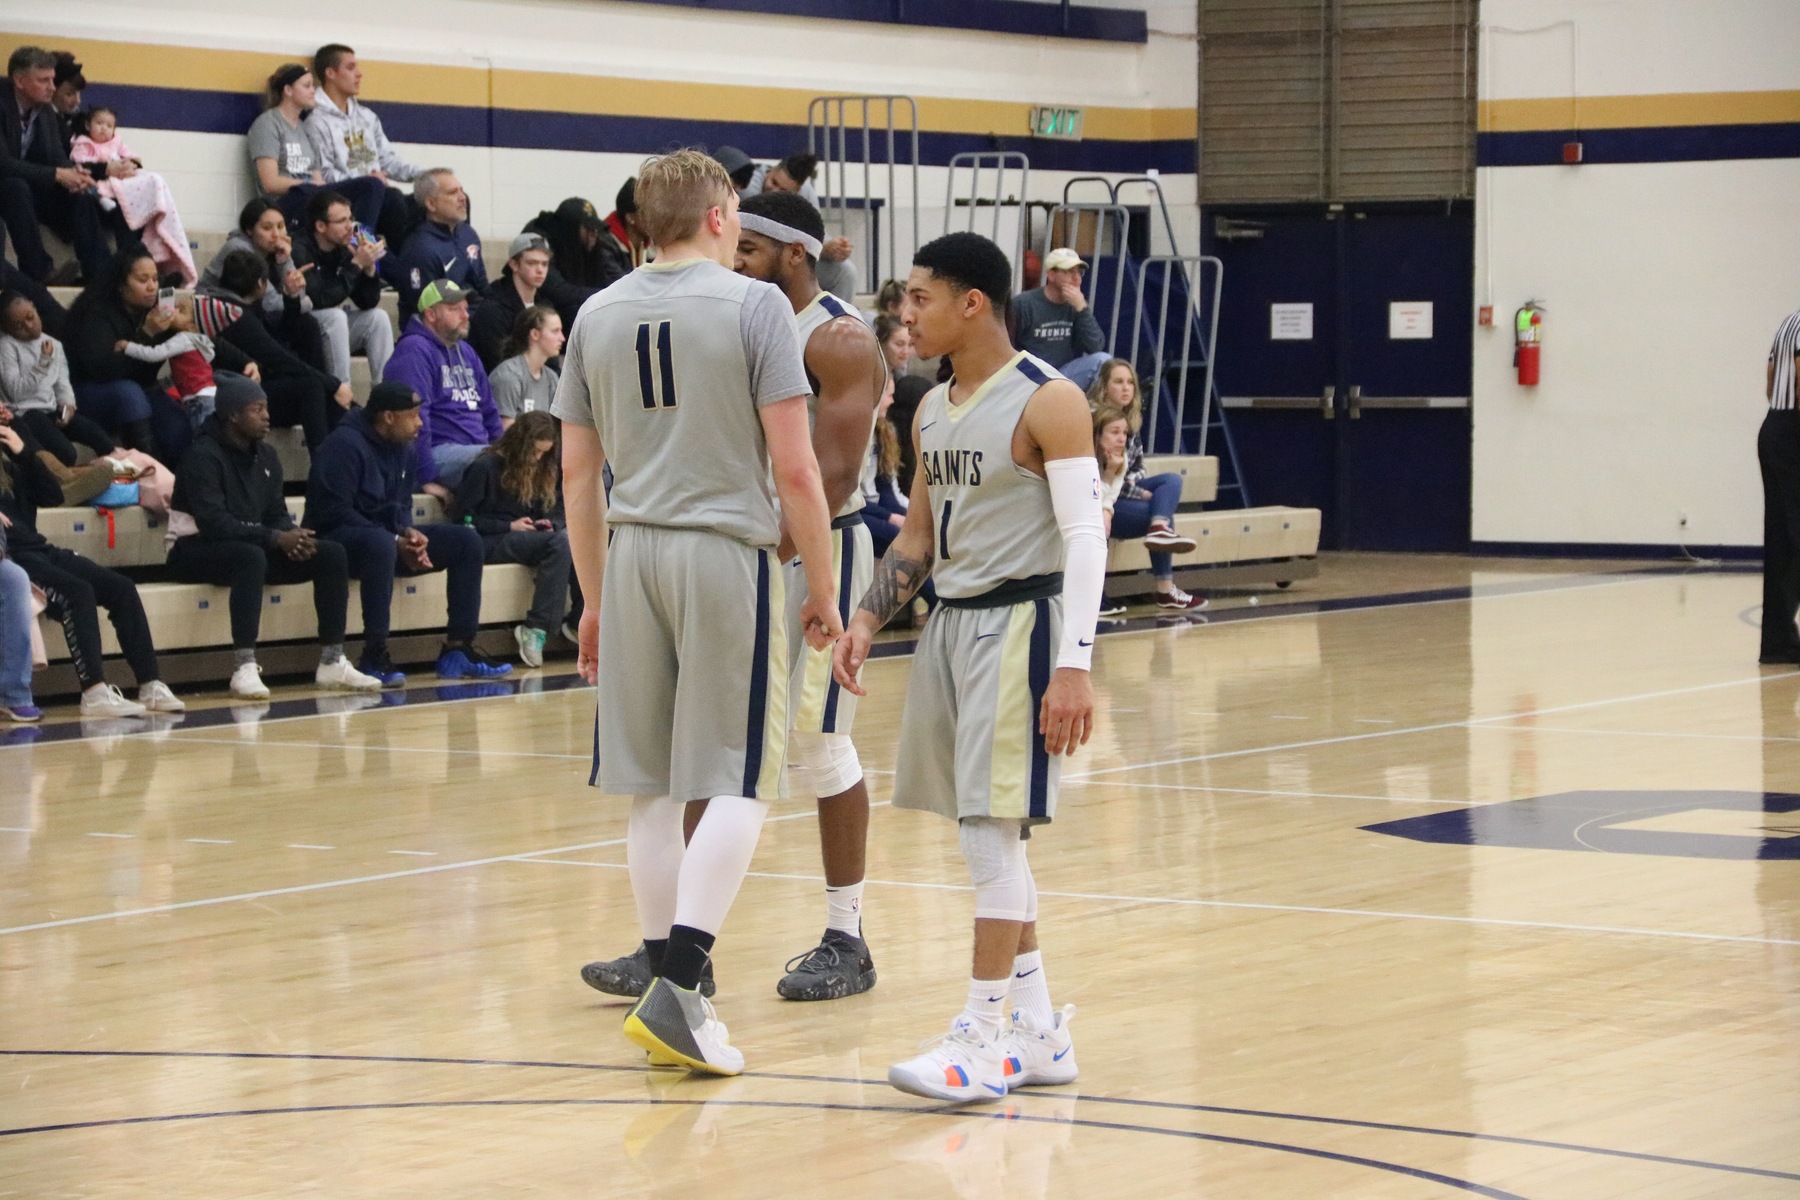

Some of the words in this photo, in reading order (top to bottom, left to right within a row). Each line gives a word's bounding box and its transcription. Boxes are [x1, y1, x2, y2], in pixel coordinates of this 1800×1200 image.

[1037, 107, 1079, 135] EXIT
[286, 143, 302, 156] EAT
[1034, 328, 1071, 338] THUNDE
[635, 319, 678, 410] 11
[922, 449, 983, 487] SAINTS
[940, 499, 953, 560] 1
